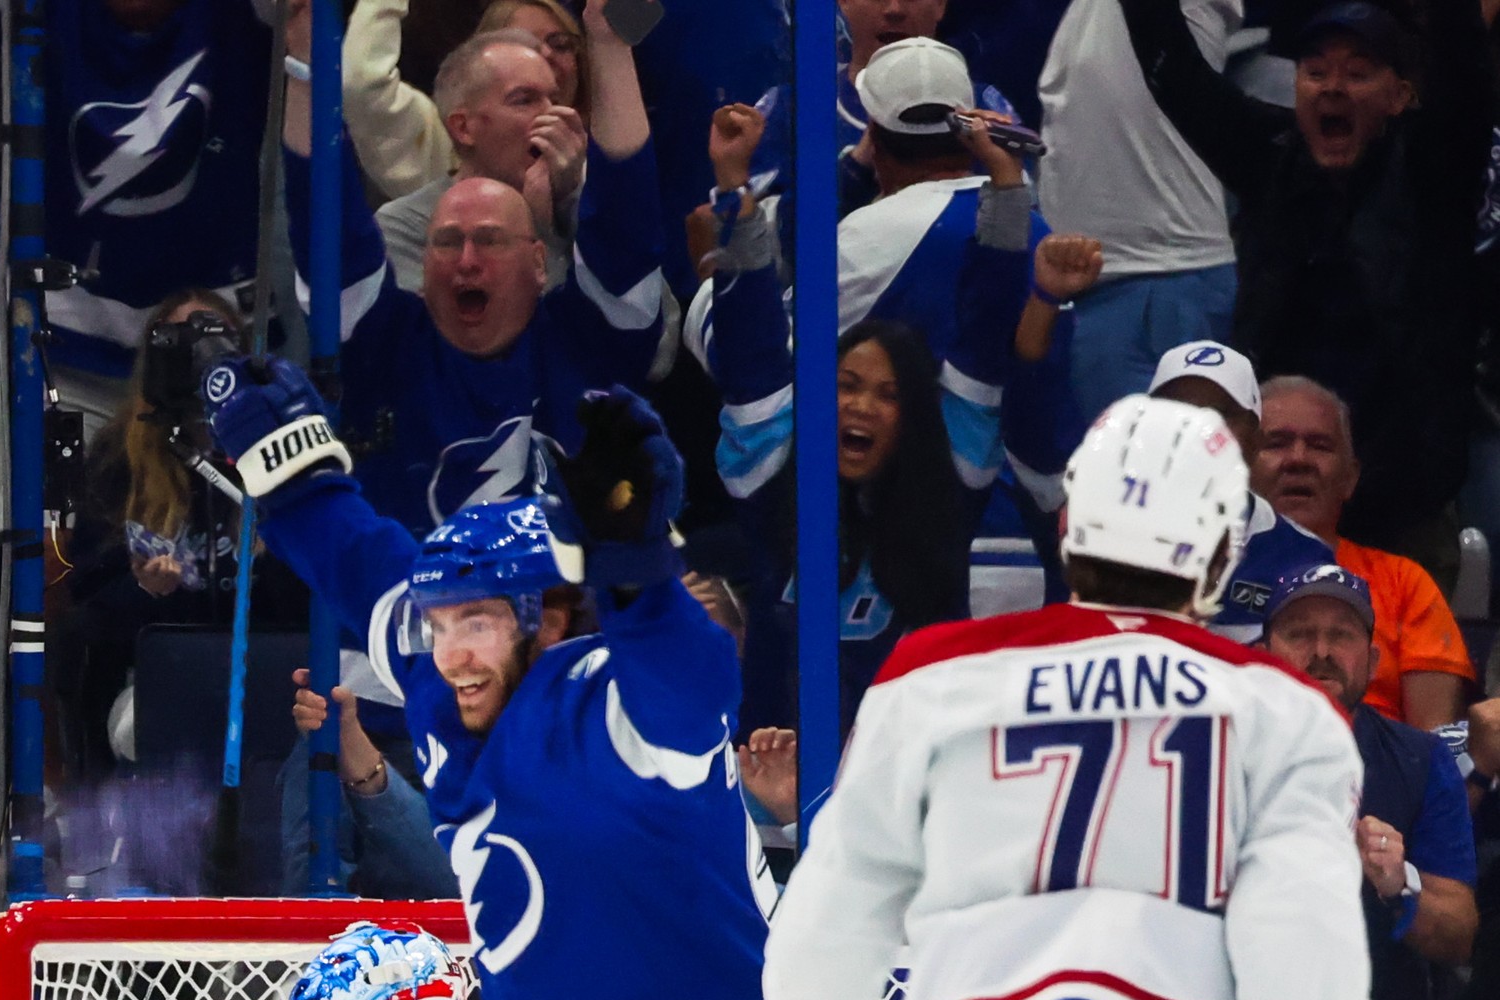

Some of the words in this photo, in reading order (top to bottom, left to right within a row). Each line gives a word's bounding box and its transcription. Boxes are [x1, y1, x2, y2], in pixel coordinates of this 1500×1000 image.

[260, 422, 337, 474] RIOR
[1121, 476, 1150, 508] 71
[1026, 654, 1208, 714] EVANS
[991, 713, 1230, 918] 71
